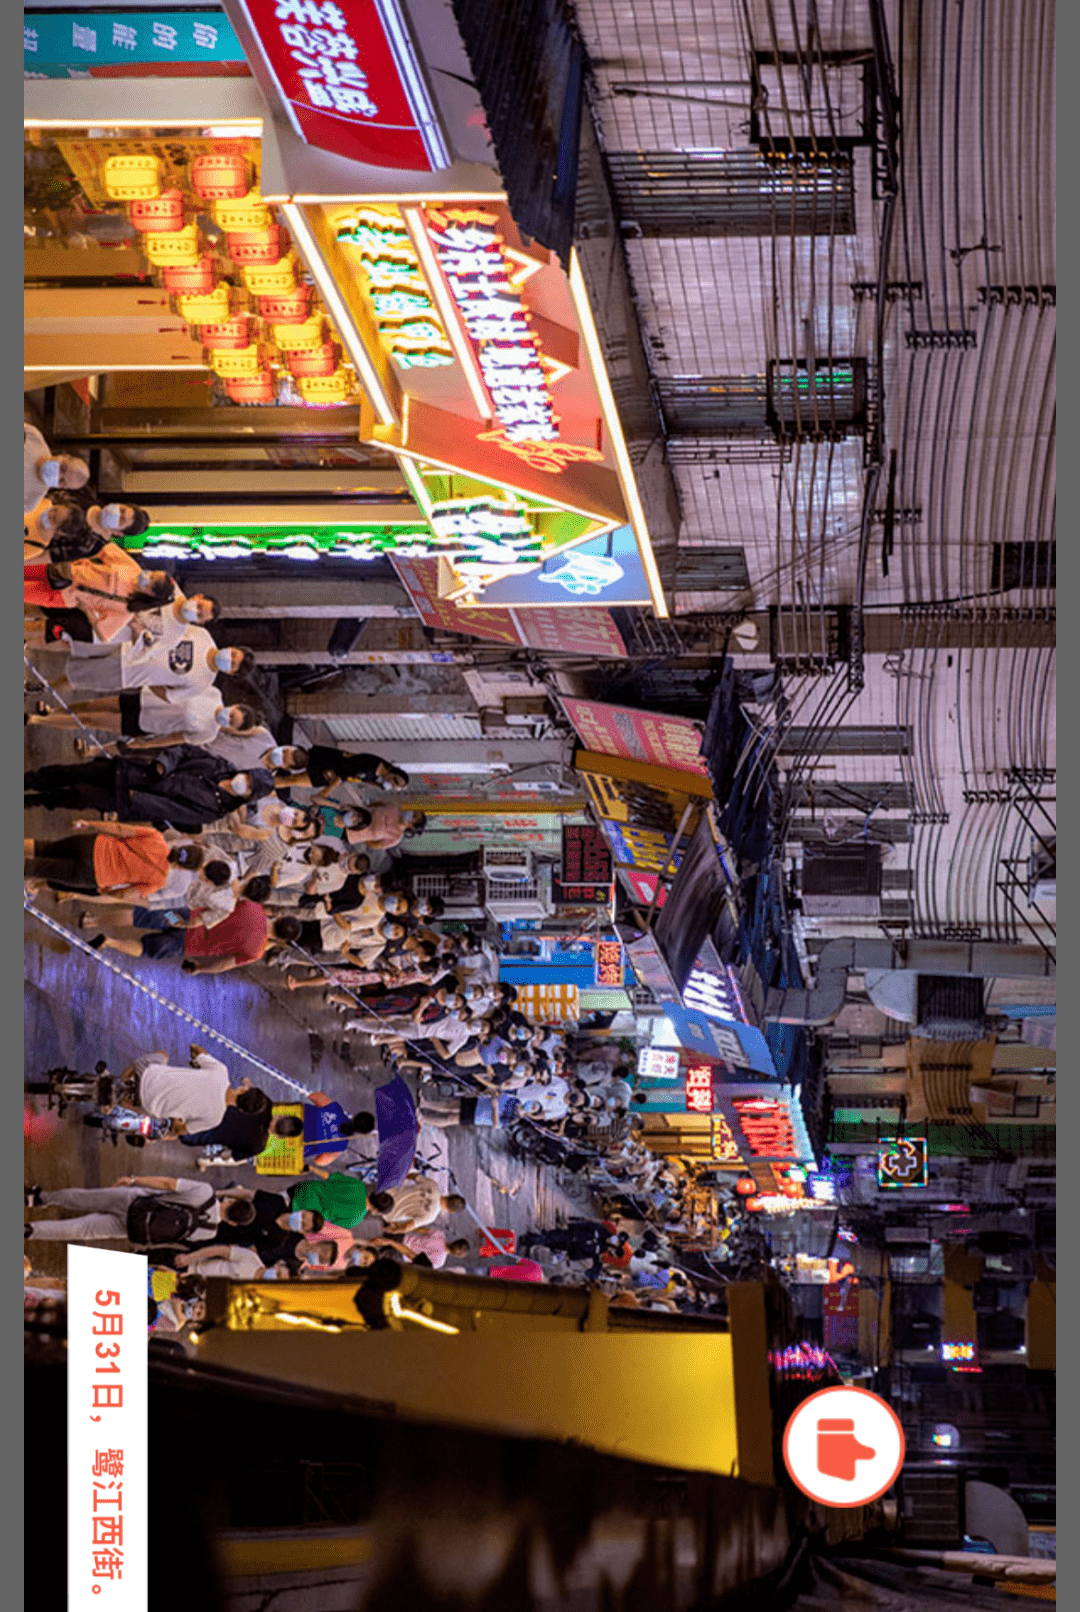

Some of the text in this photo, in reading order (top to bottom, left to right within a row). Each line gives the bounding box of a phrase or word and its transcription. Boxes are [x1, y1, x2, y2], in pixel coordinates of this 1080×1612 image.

[274, 0, 379, 118] 芙蓉兴盛
[427, 227, 531, 341] 乡村土食材
[598, 944, 622, 983] 烧烤
